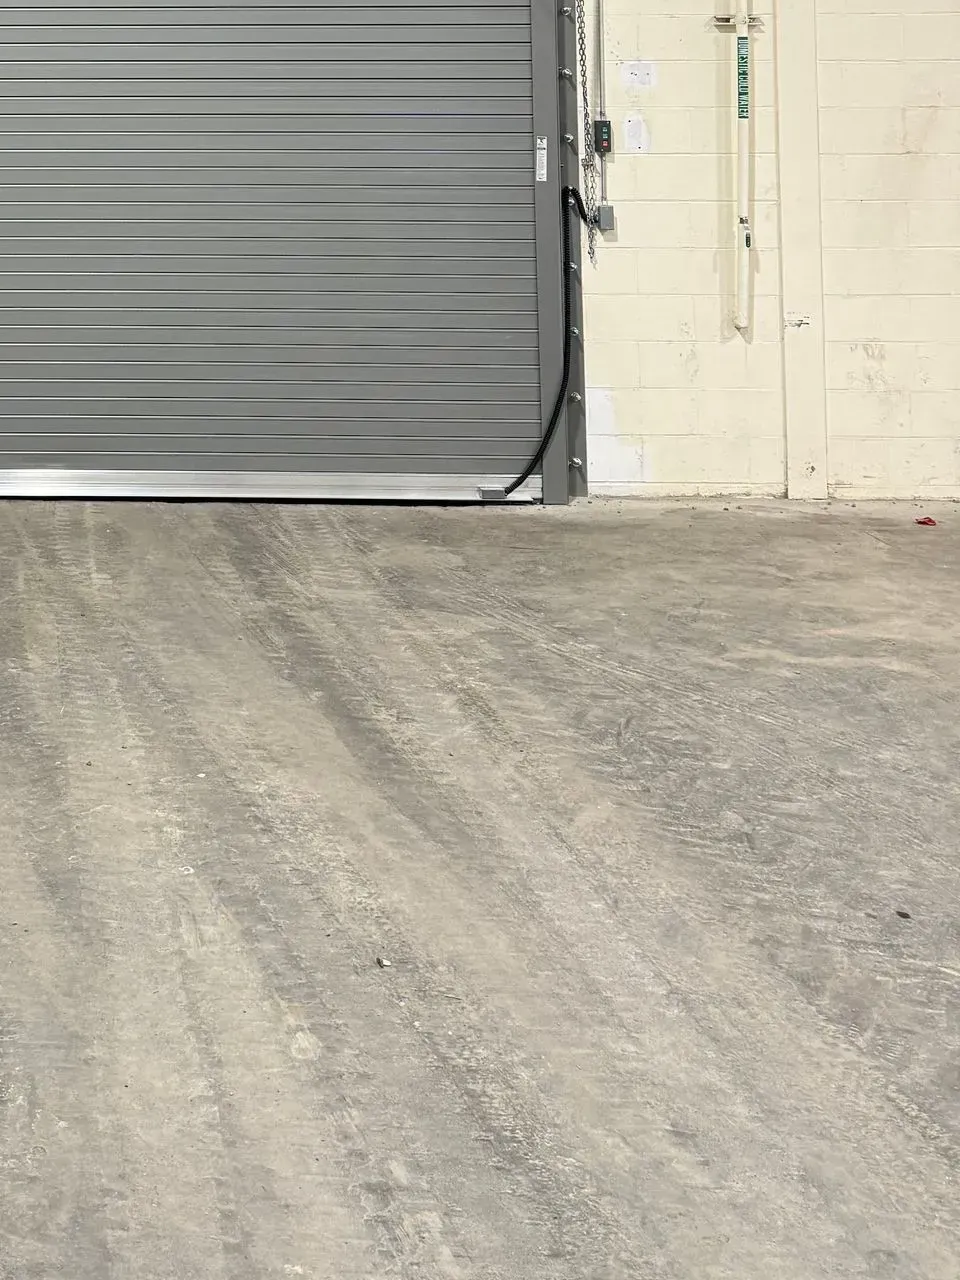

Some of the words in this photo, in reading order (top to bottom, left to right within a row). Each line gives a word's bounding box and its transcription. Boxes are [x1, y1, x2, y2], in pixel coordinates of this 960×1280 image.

[738, 39, 749, 74] DOMESTIC
[738, 75, 749, 93] COLD
[738, 94, 749, 117] WATER
